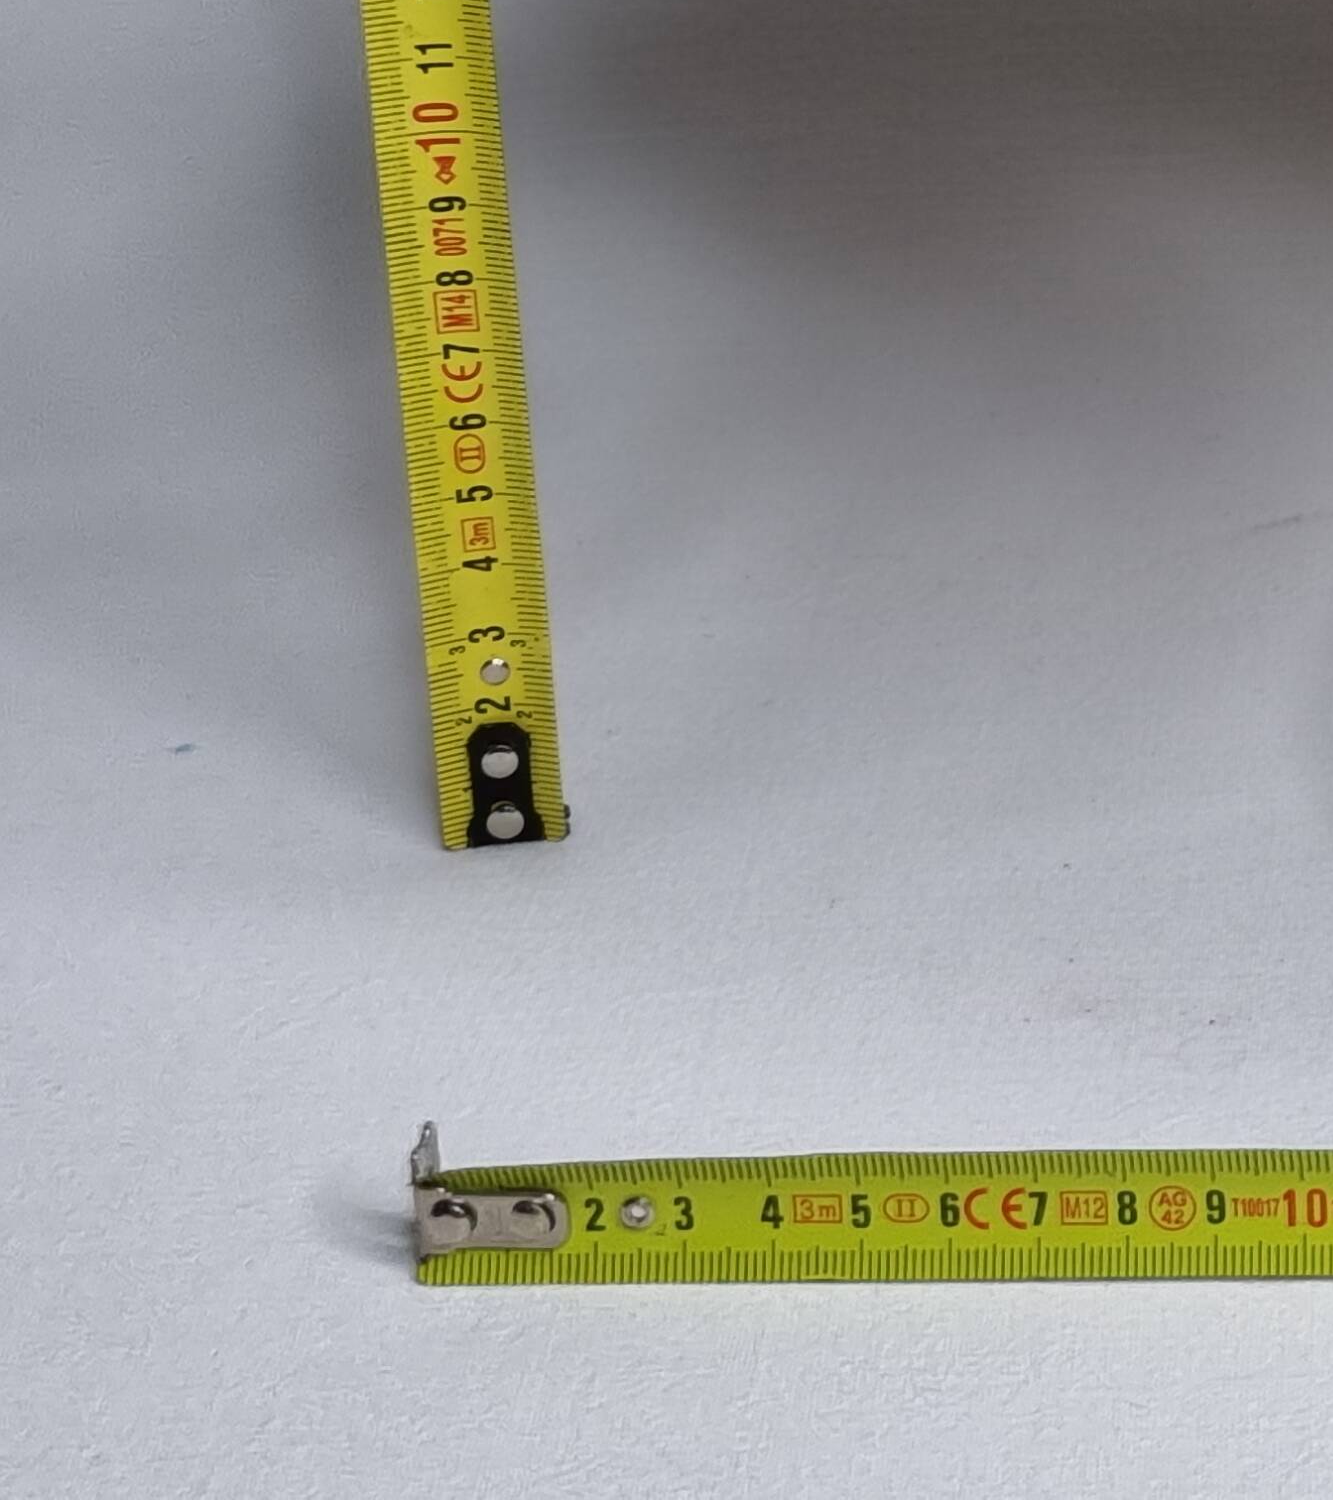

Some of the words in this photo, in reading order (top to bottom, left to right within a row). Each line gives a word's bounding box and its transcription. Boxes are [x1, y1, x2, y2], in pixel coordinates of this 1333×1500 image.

[414, 43, 454, 74] 11
[411, 100, 462, 154] 10
[428, 195, 467, 213] 9
[431, 216, 469, 257] 0071
[435, 269, 474, 287] 8
[440, 292, 475, 329] M14
[442, 343, 480, 360] 7
[439, 362, 485, 405] CE
[448, 413, 487, 431] 6
[455, 485, 494, 504] 5
[468, 520, 490, 547] 3m
[461, 555, 499, 572] 4
[467, 625, 506, 644] 3
[510, 639, 526, 648] 3
[448, 645, 466, 656] 3
[473, 695, 512, 715] 2
[458, 716, 473, 725] 2
[516, 710, 533, 719] 2
[1157, 1191, 1189, 1208] AG
[584, 1197, 606, 1232] 2
[673, 1196, 694, 1231] 3
[760, 1194, 784, 1229] 4
[797, 1199, 838, 1220] 3m
[850, 1194, 871, 1229] 5
[939, 1192, 960, 1228] 6
[963, 1187, 1028, 1230] CE
[1028, 1191, 1048, 1226] 7
[1063, 1195, 1107, 1221] M12
[1117, 1190, 1138, 1226] 8
[1205, 1189, 1226, 1225] 9
[1281, 1187, 1330, 1228] 10
[1160, 1209, 1186, 1227] 42
